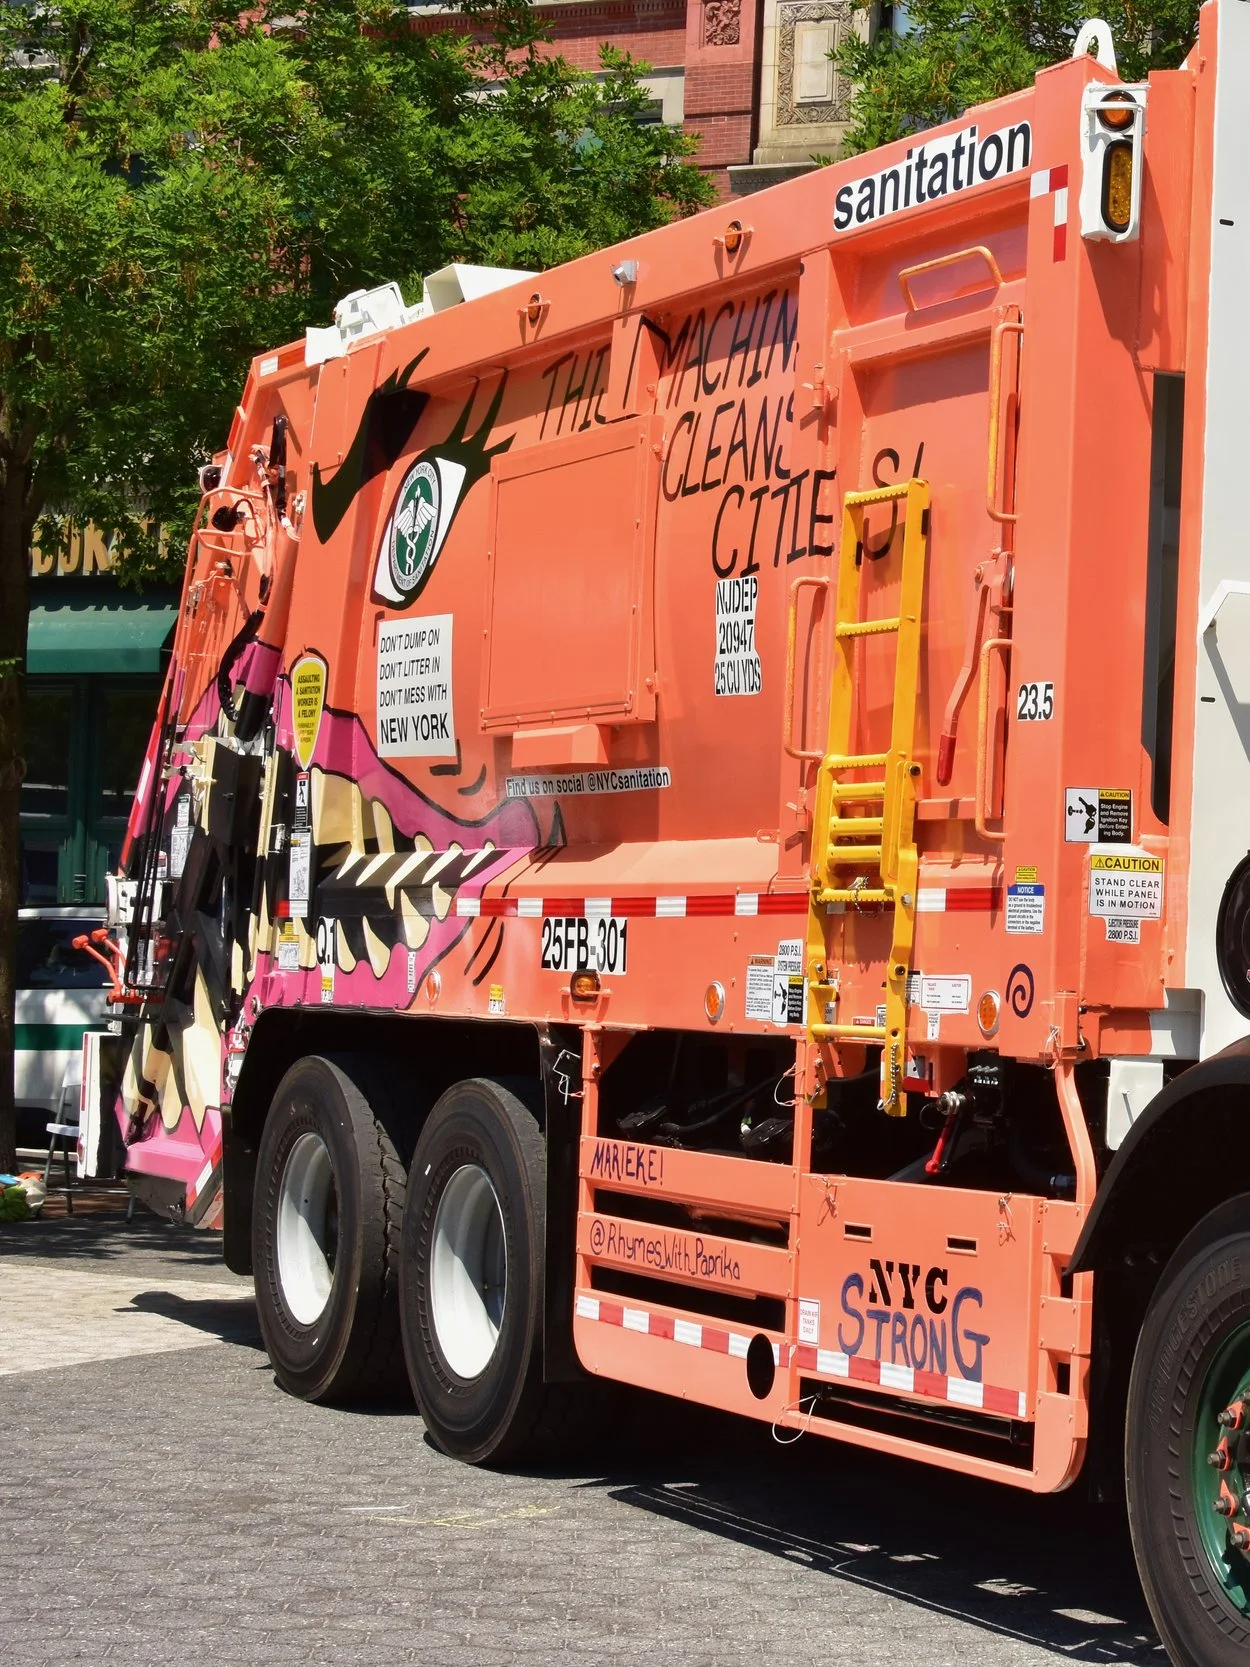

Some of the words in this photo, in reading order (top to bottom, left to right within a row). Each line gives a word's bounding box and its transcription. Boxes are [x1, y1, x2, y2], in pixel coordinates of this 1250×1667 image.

[834, 123, 1031, 230] sanitation
[415, 466, 428, 478] YORK
[427, 468, 437, 484] CITY
[716, 577, 757, 615] NJDEP
[380, 634, 403, 653] DON'T
[404, 631, 427, 650] DUMP
[428, 628, 440, 646] ON
[719, 619, 753, 655] 20947
[380, 662, 402, 680] DON'T
[403, 658, 430, 677] LITTER
[432, 656, 441, 673] IN
[715, 661, 726, 695] 25
[726, 660, 740, 694] CU
[741, 657, 760, 693] YDS
[380, 689, 403, 707] DON'T
[404, 686, 425, 704] MESS
[428, 684, 447, 701] WITH
[1017, 684, 1053, 720] 23.5
[381, 716, 408, 744] NEW
[412, 713, 450, 741] YORK
[507, 777, 527, 796] Find
[529, 780, 540, 794] us
[542, 779, 554, 793] on
[556, 776, 585, 793] social
[588, 770, 669, 792] @NYCsanitation
[1105, 858, 1159, 871] CAUTION
[1017, 886, 1034, 894] NOTICE
[1095, 877, 1125, 886] STAND
[1129, 880, 1160, 888] CLEAR
[1096, 889, 1125, 897] WHILE
[1128, 890, 1158, 899] PANEL
[1096, 899, 1104, 907] IS
[1120, 900, 1155, 909] MOTION
[541, 918, 627, 973] 25FB-301
[590, 1142, 664, 1186] MARIEKE!
[590, 1220, 741, 1280] @Rhymes_With_Paprika
[869, 1258, 948, 1314] NYC
[837, 1272, 990, 1382] STRONG
